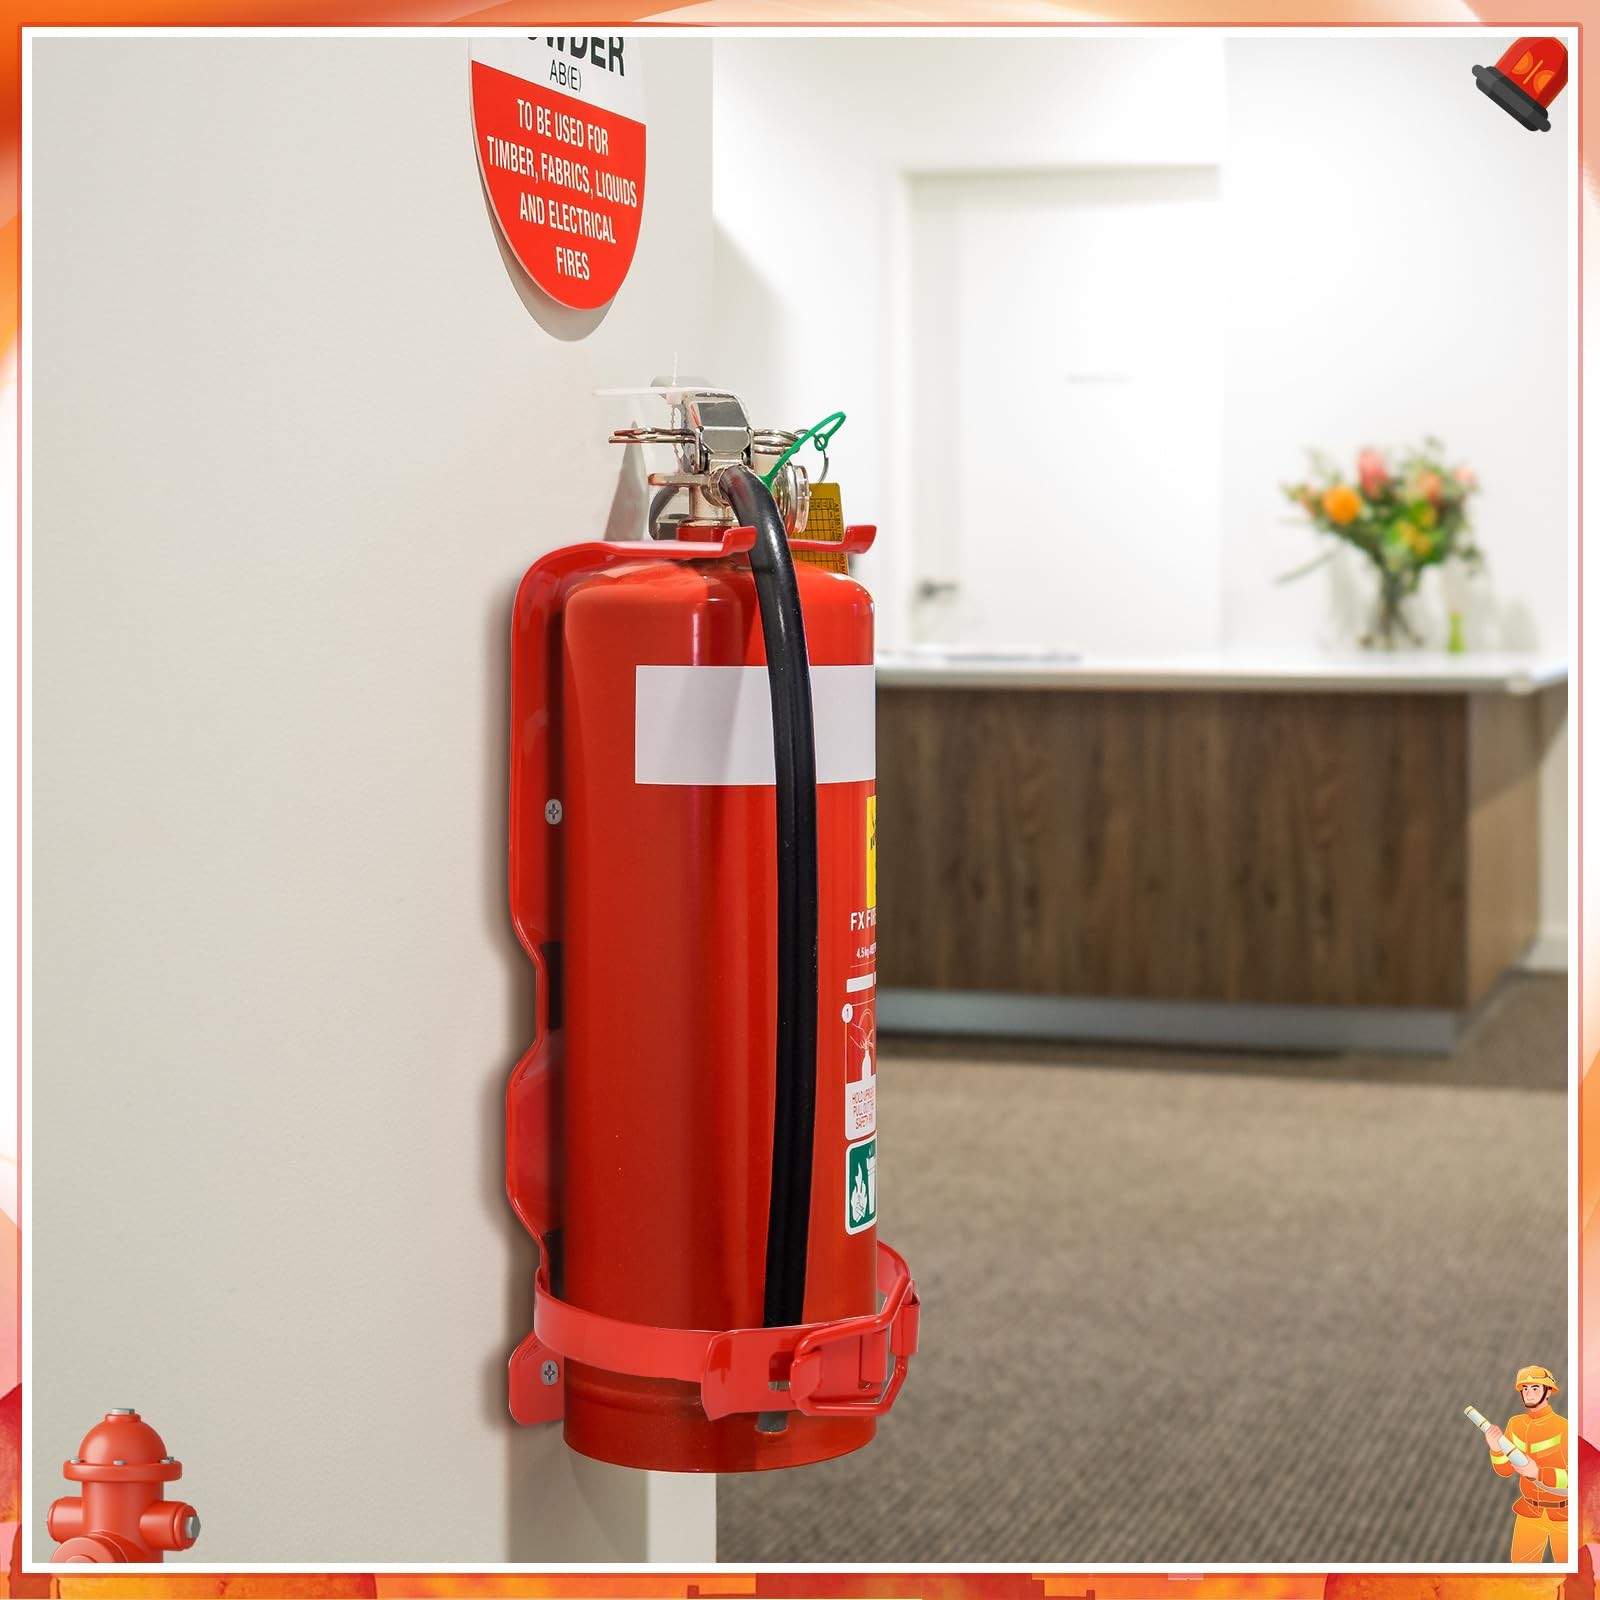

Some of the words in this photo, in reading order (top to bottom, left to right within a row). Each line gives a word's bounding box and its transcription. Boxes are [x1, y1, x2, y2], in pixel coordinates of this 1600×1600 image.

[549, 59, 582, 92] AB(E)
[516, 98, 533, 131] TO
[537, 105, 552, 138] BE
[554, 112, 584, 148] USED
[587, 123, 609, 156] FOR
[486, 135, 539, 184] TIMBER,
[540, 152, 594, 198] FABRICS,
[595, 169, 637, 208] LIQUIDS
[520, 191, 545, 225] AND
[549, 201, 617, 244] ELECTRICAL
[556, 246, 590, 281] FIRES
[850, 911, 865, 931] FX
